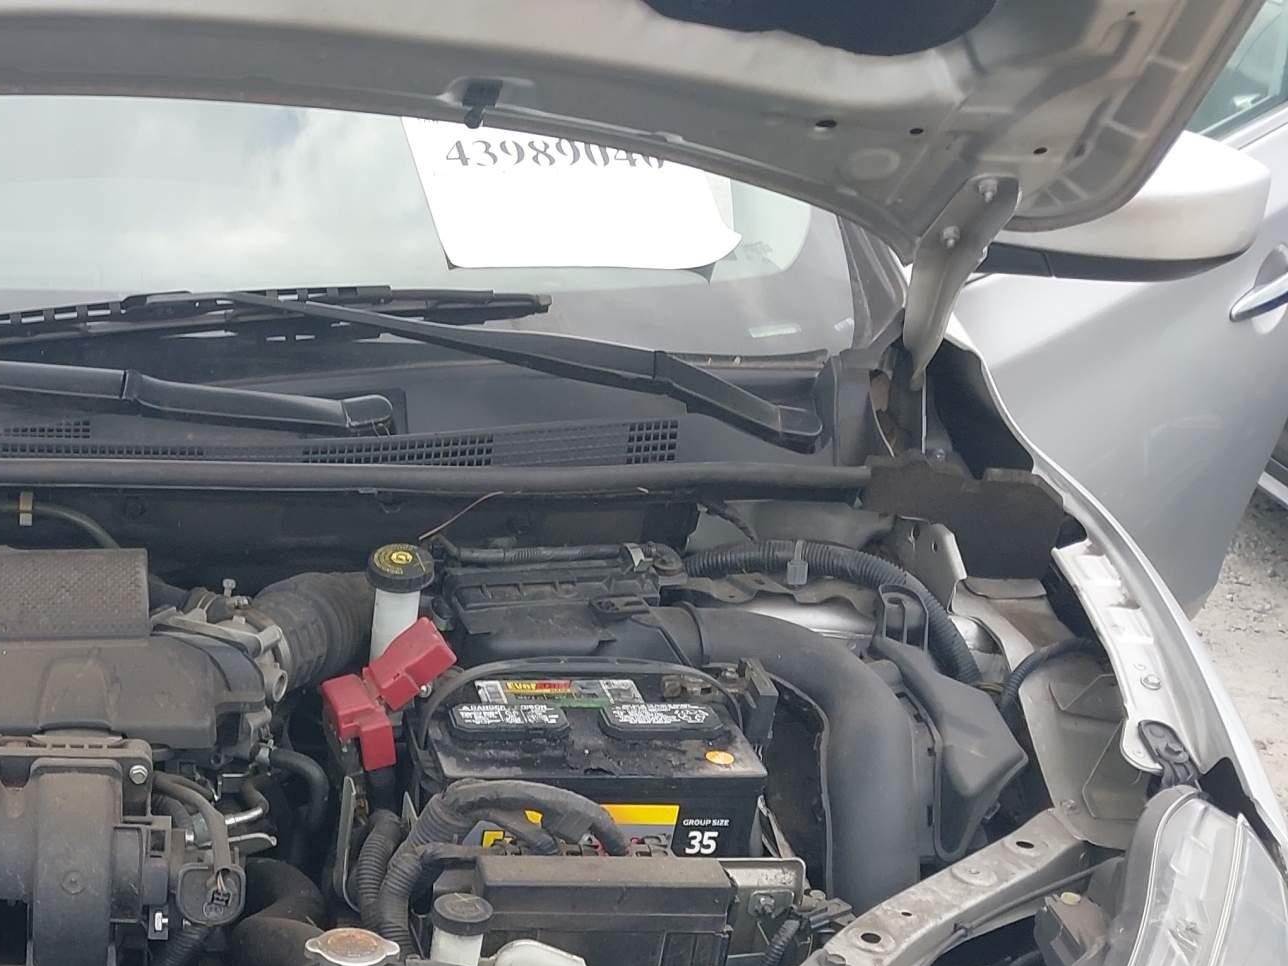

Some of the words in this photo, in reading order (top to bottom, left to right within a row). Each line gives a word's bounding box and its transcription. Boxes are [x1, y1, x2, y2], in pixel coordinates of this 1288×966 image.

[682, 819, 711, 827] GROUP
[712, 819, 730, 827] SIZE
[685, 830, 719, 855] 35
